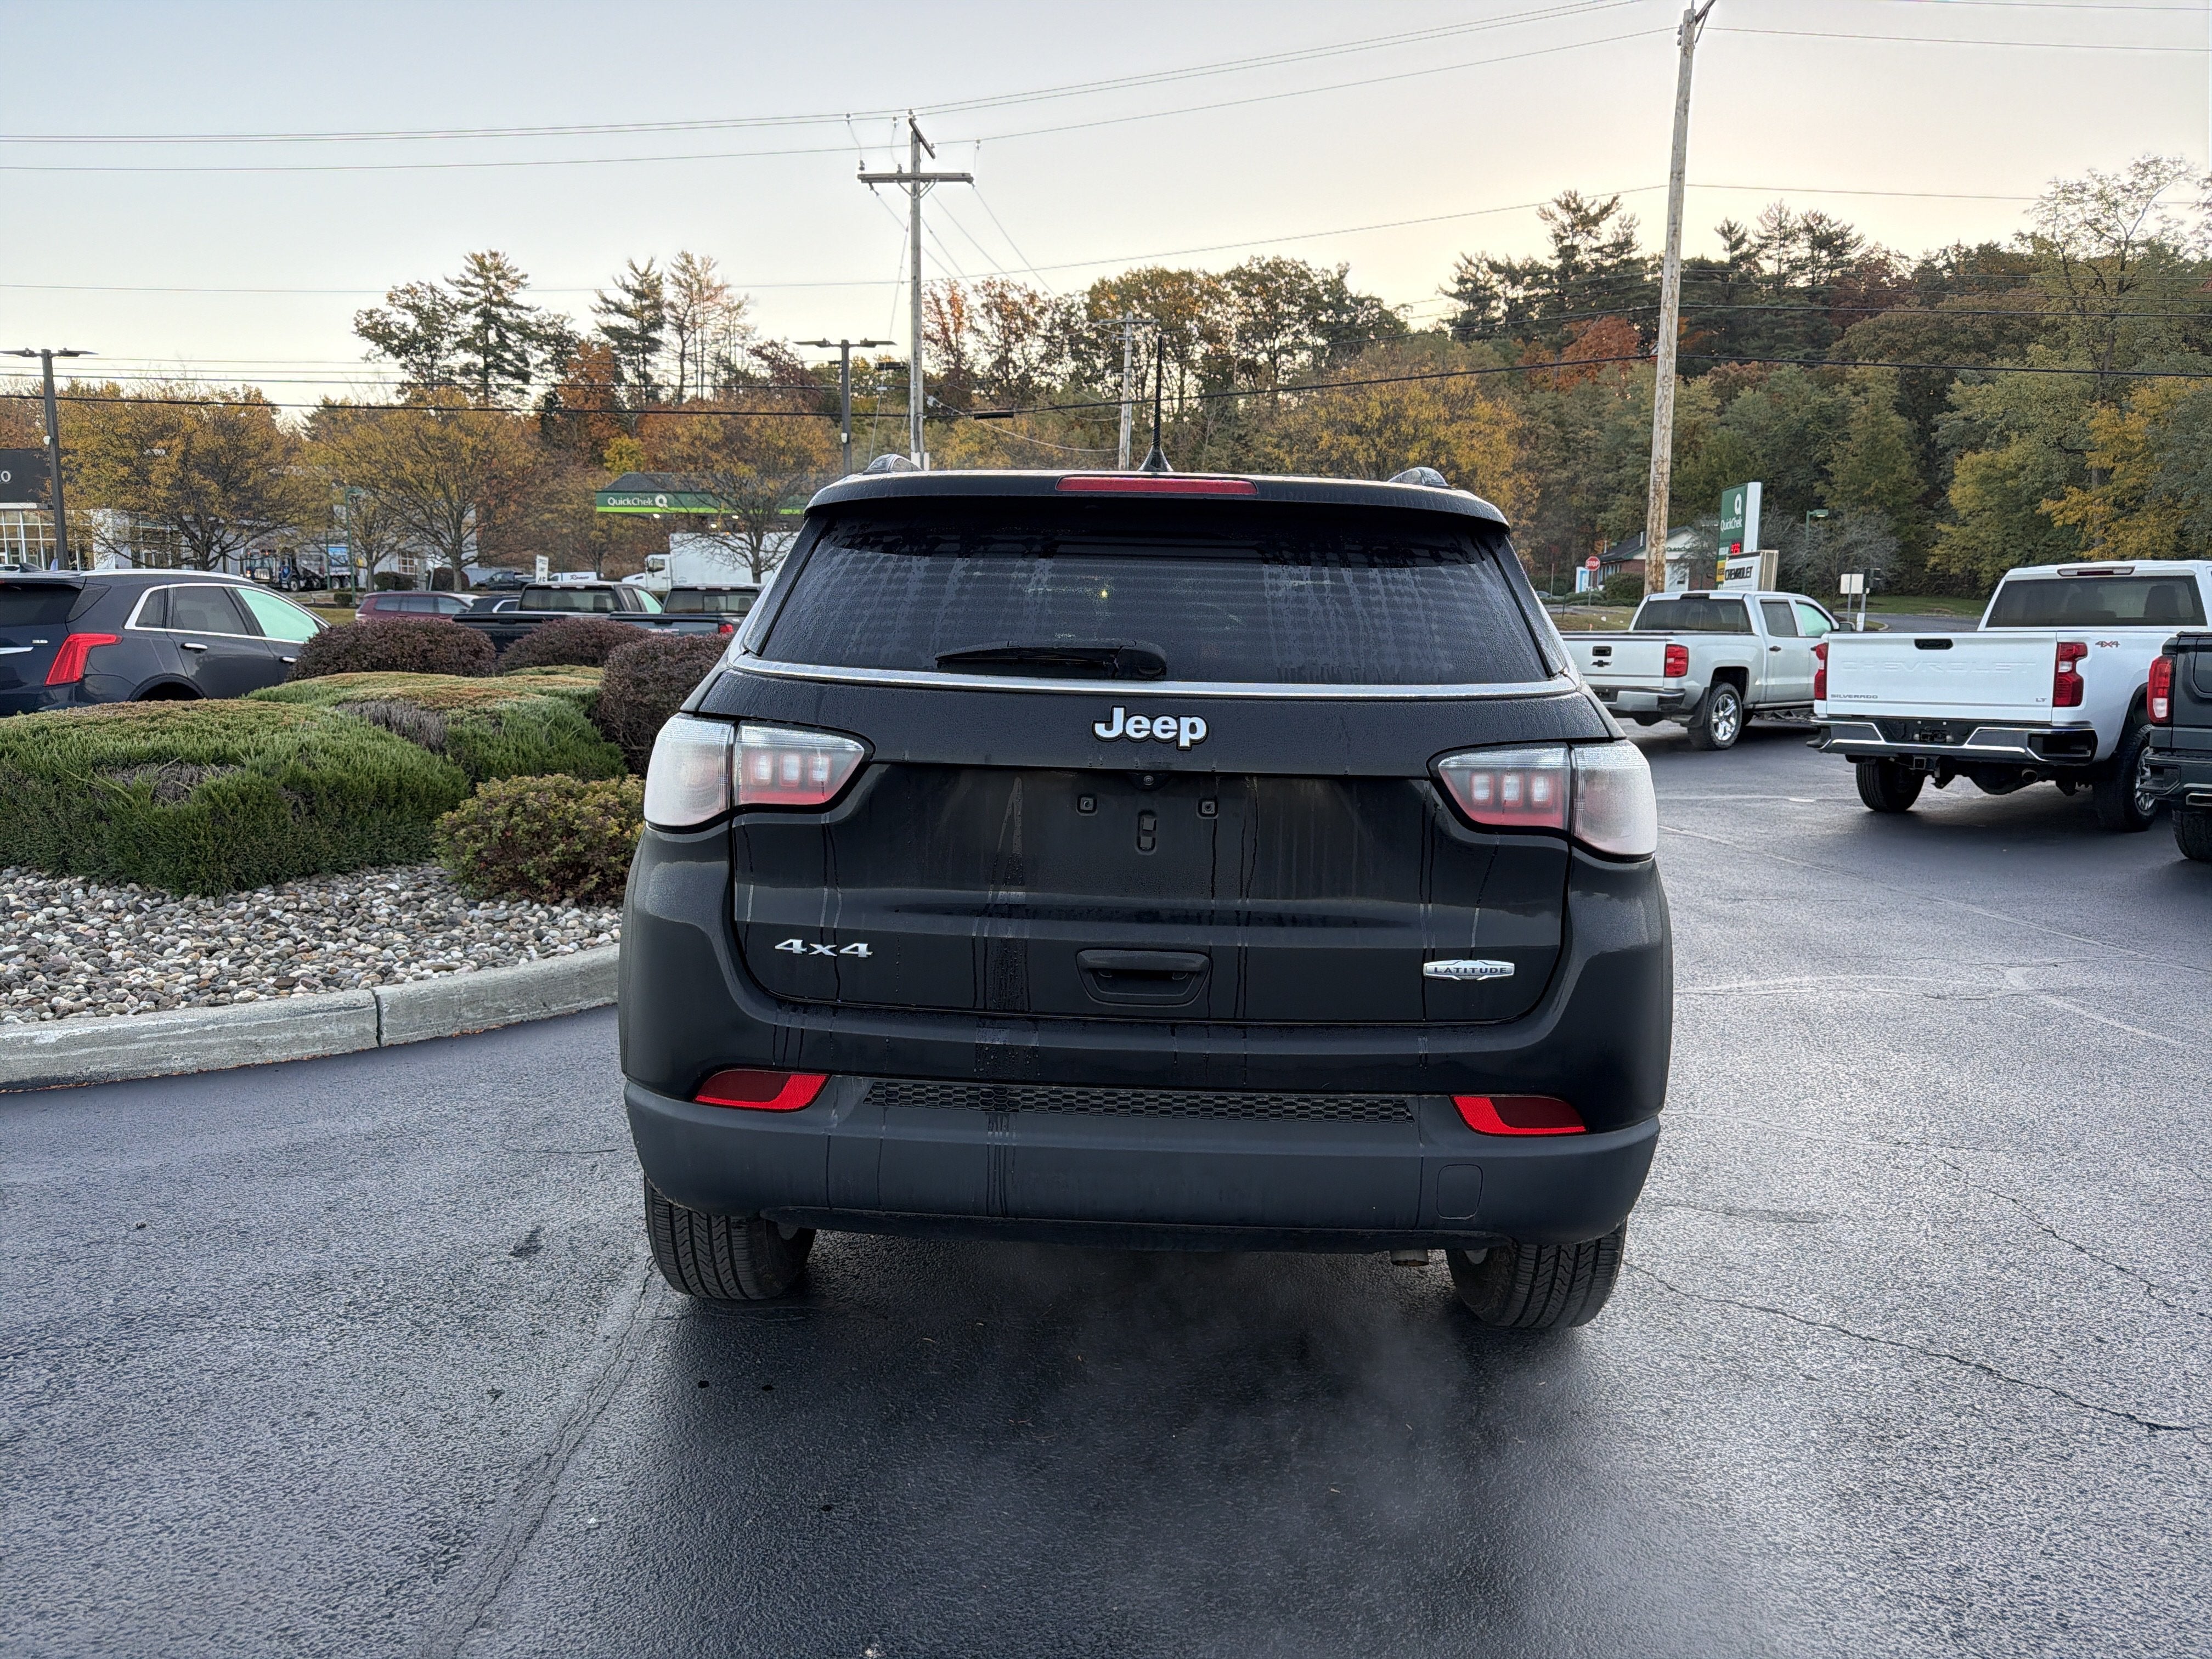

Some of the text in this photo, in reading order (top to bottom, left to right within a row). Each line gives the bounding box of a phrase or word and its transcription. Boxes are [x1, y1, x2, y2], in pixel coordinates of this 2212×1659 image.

[607, 497, 653, 506] QuickChek
[1720, 516, 1742, 533] QuickChek
[1724, 566, 1753, 580] CHEVROLET
[1094, 706, 1207, 749] Jeep
